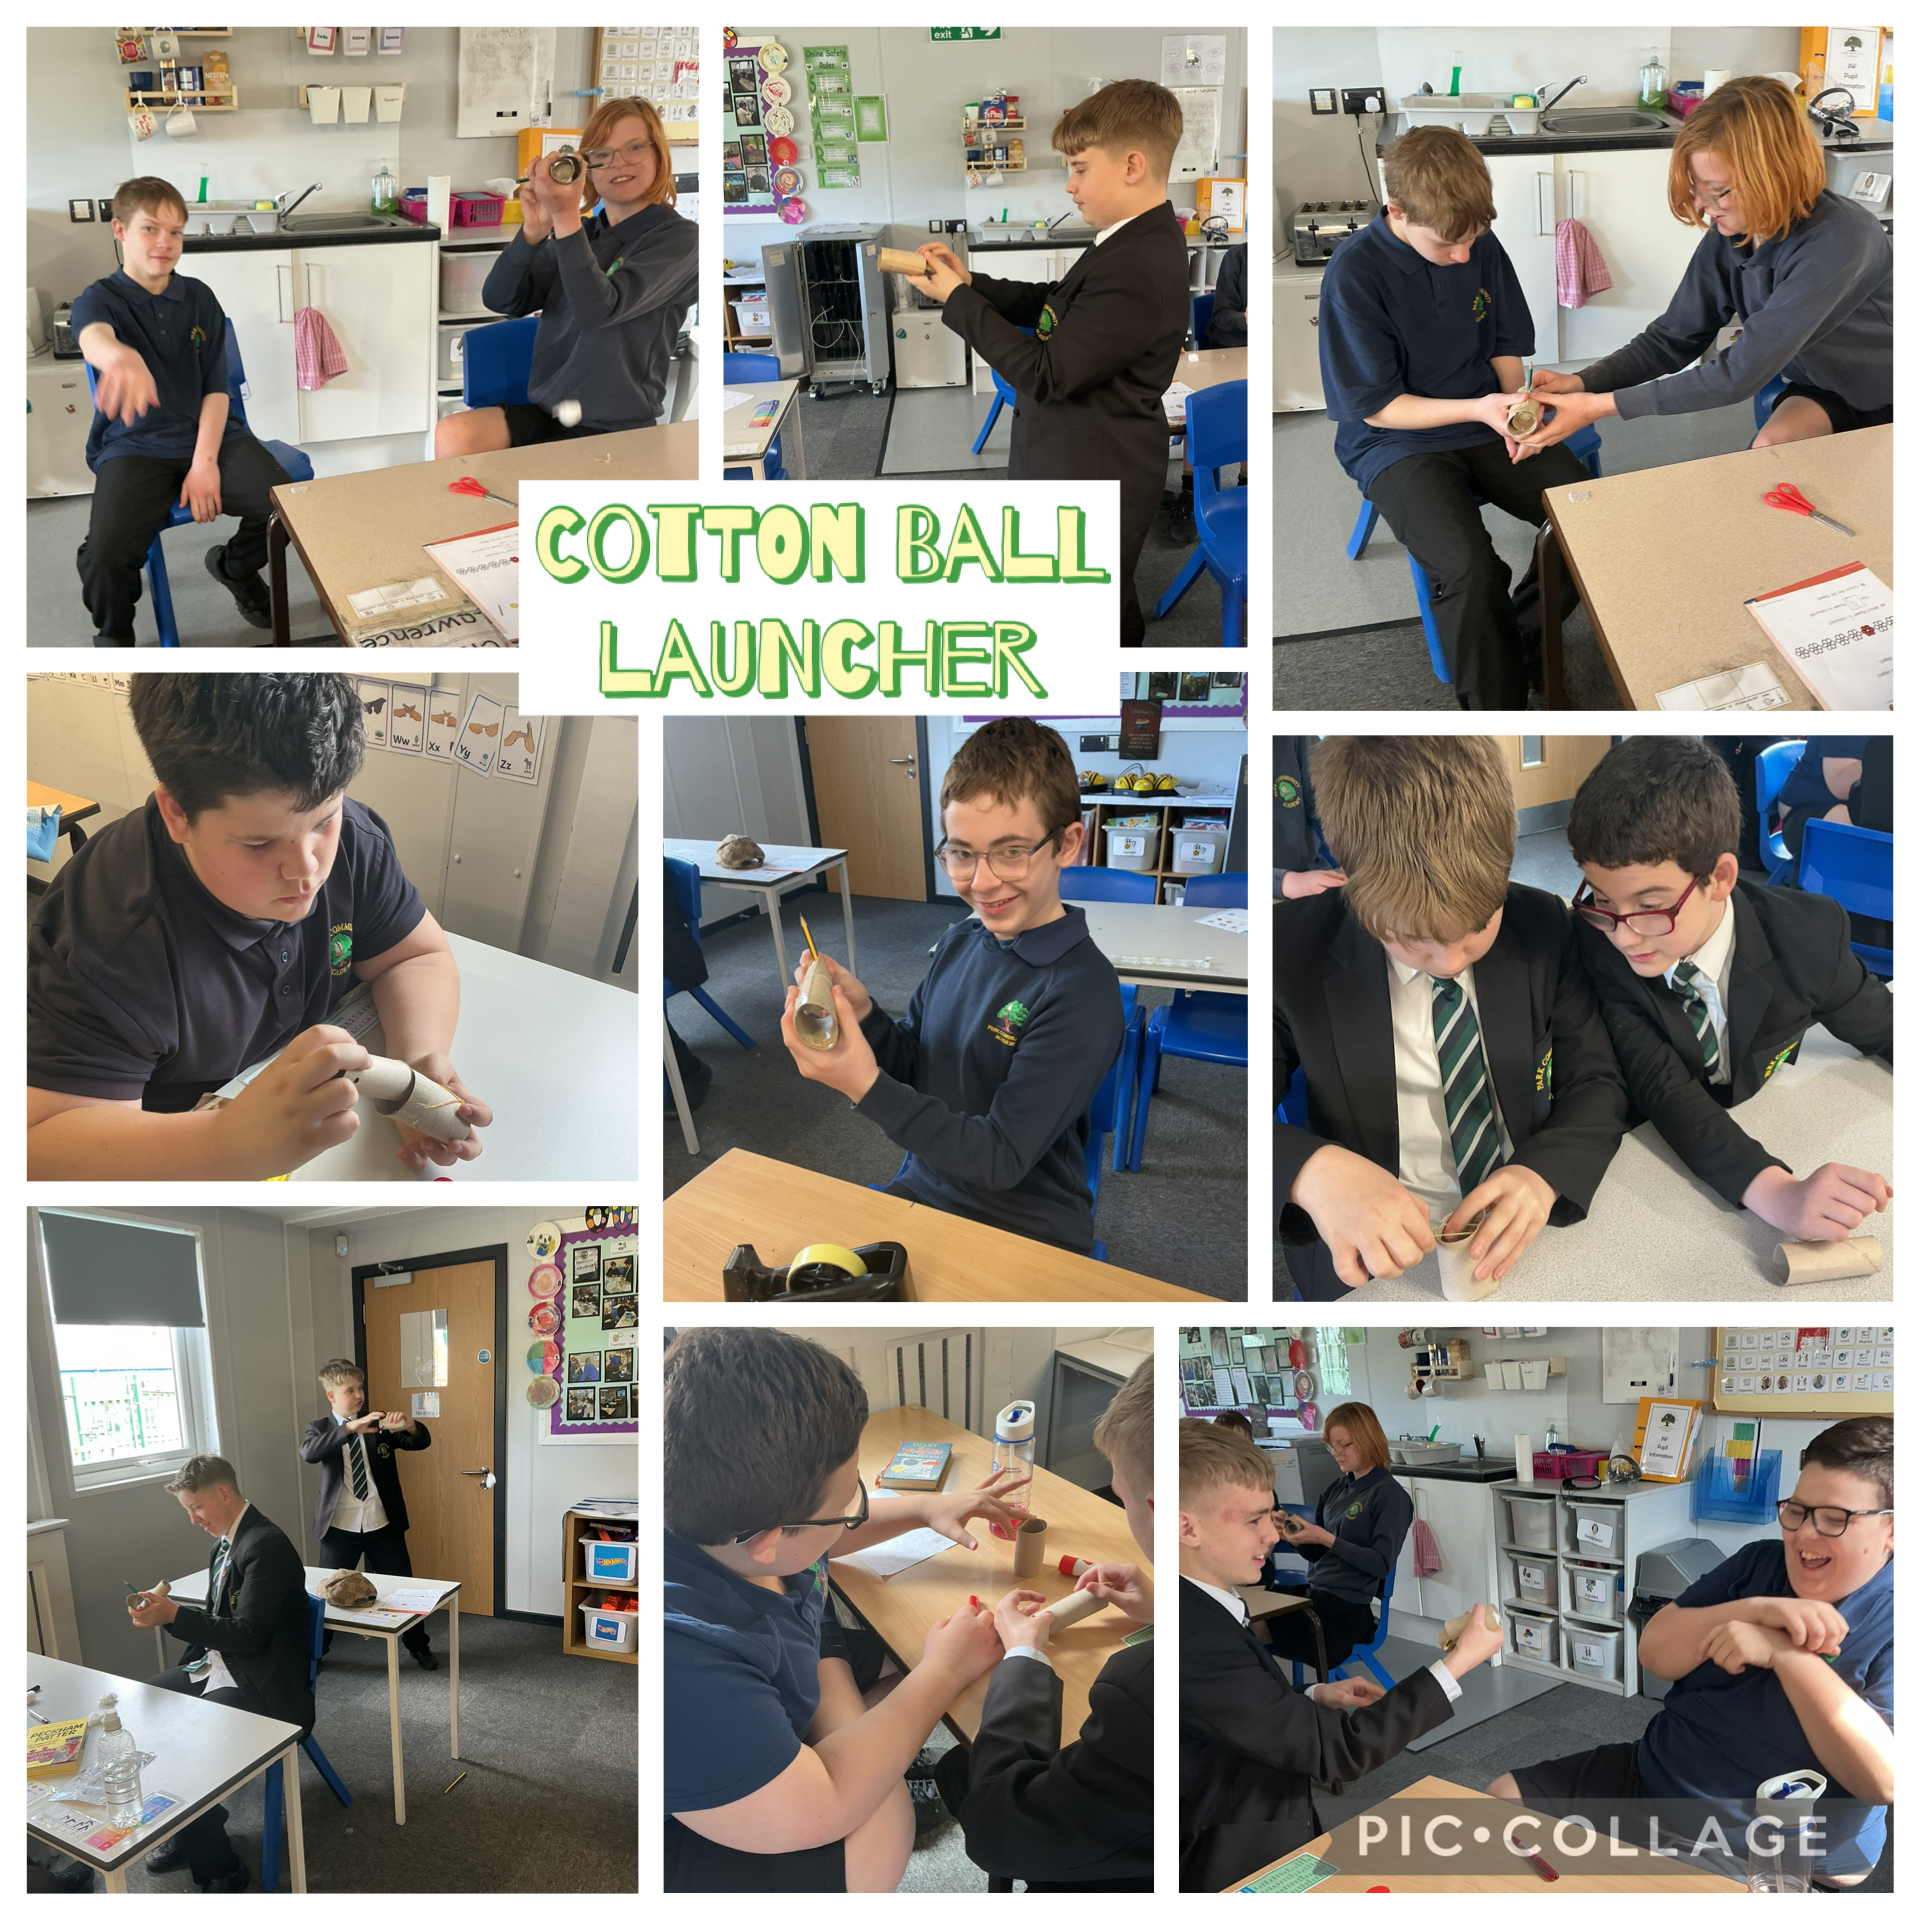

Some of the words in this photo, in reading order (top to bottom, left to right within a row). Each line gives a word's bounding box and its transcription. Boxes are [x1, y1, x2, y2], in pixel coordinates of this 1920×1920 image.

[934, 30, 952, 39] exit
[805, 49, 824, 58] Online
[825, 48, 847, 59] Safety
[819, 61, 835, 70] Rules
[1843, 72, 1859, 80] Pupil
[114, 679, 125, 688] Mm
[393, 734, 410, 746] Ww
[428, 741, 441, 753] Xx
[459, 744, 471, 760] Yy
[499, 759, 512, 771] Zz
[1535, 1067, 1546, 1091] PARK
[1656, 1443, 1669, 1451] Pupil
[1649, 1451, 1674, 1460] Information
[1584, 1533, 1604, 1544] Headphones
[30, 1722, 84, 1739] PECKHAM
[34, 1729, 77, 1743] PATTER
